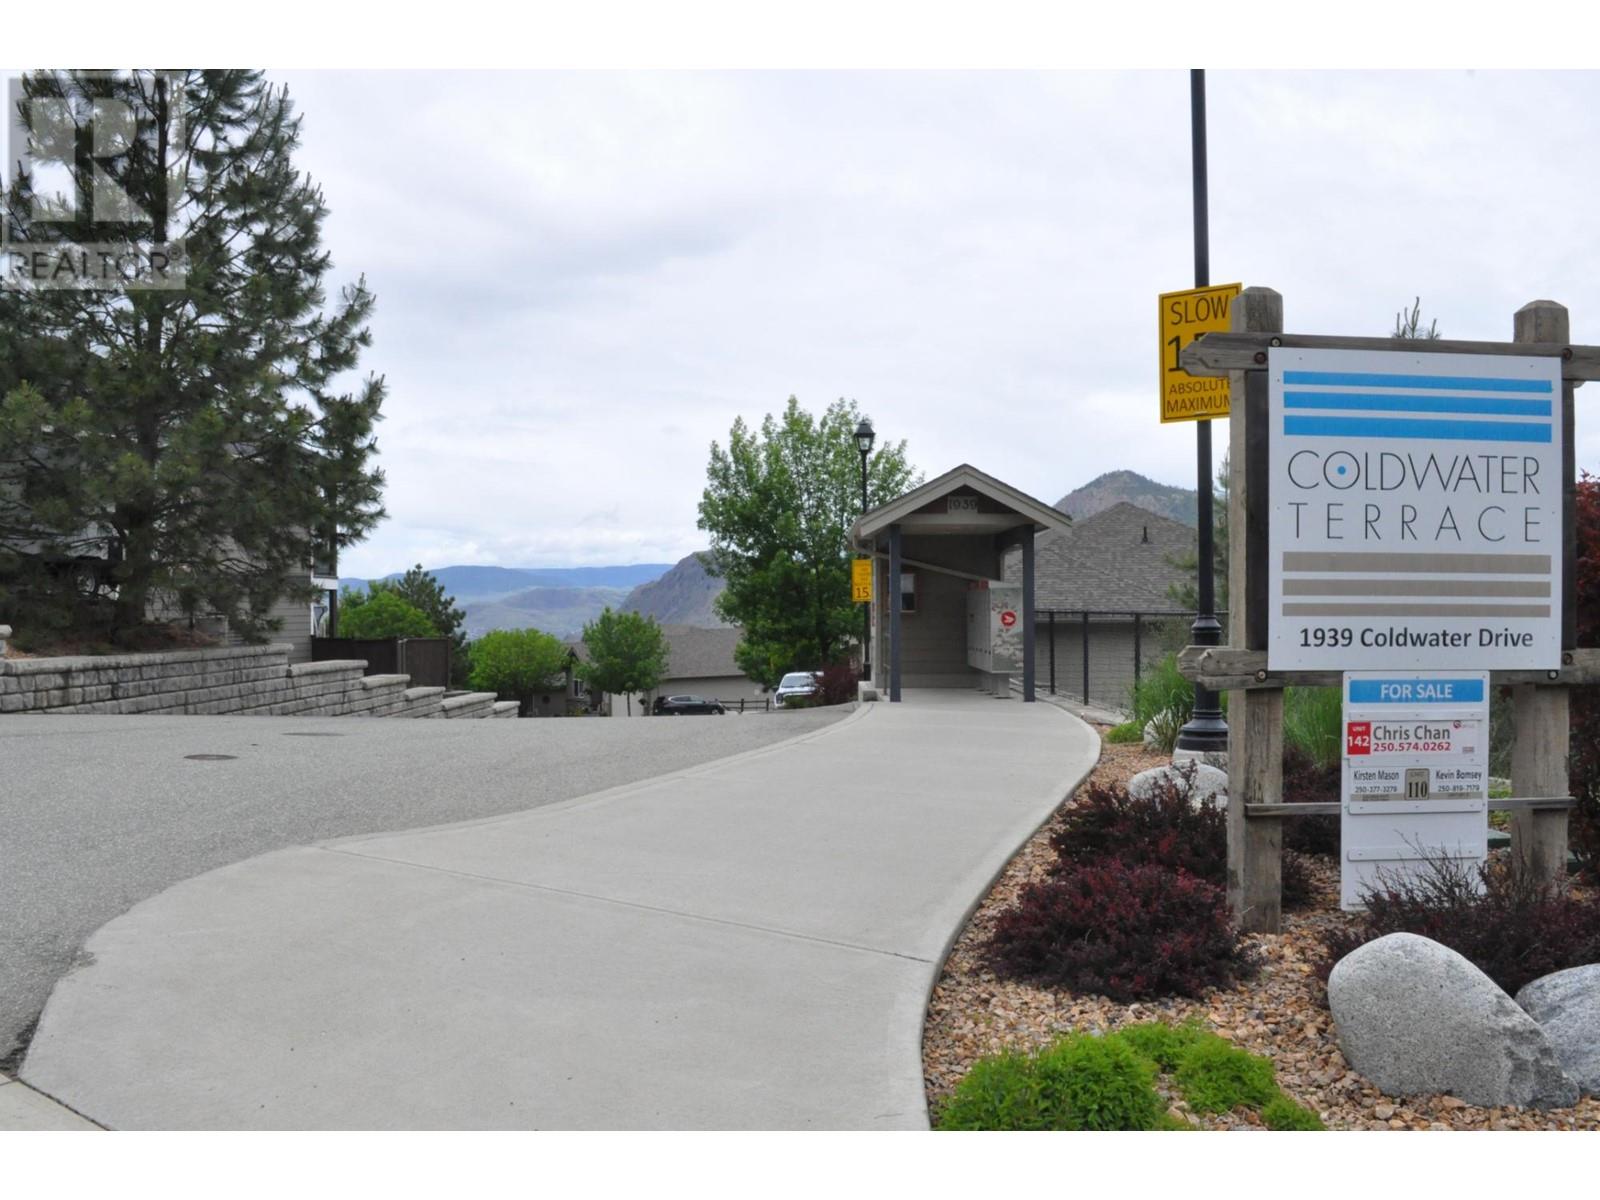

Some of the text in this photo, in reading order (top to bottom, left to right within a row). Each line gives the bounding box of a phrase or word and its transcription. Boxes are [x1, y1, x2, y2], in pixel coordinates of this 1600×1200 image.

[1171, 295, 1229, 325] SLOW
[1288, 449, 1541, 495] COLDWATER
[1288, 502, 1541, 543] TERRACE
[856, 587, 869, 598] 15
[1300, 627, 1534, 648] 1939 Coldwater Drive
[1380, 684, 1453, 698] FOR SALE
[1373, 725, 1450, 740] Chris Chan
[1348, 736, 1370, 747] 142
[1373, 742, 1451, 752] 250.574.0262
[1378, 770, 1399, 780] Mason
[1436, 770, 1454, 780] Kevin
[1408, 781, 1428, 798] 110
